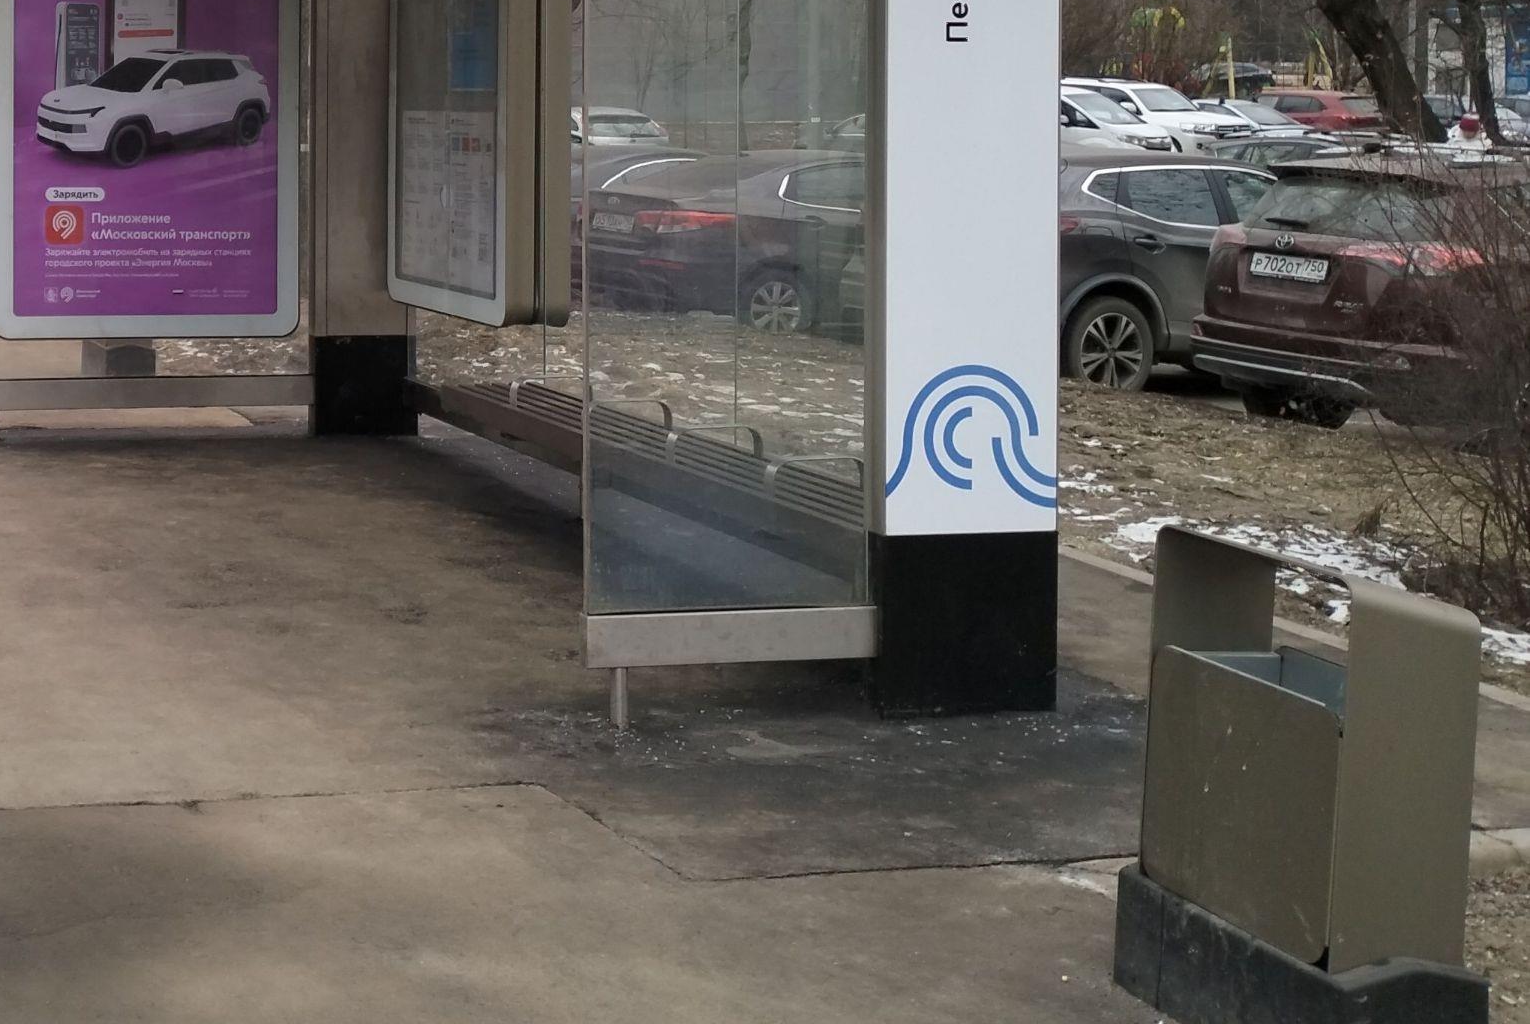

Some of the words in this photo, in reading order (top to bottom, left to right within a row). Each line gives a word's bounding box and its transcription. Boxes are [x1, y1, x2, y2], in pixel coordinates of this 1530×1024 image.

[52, 190, 99, 199] Зарядить
[91, 212, 171, 225] Приложение
[91, 228, 176, 240] «Московский
[179, 230, 251, 241] транспорт»
